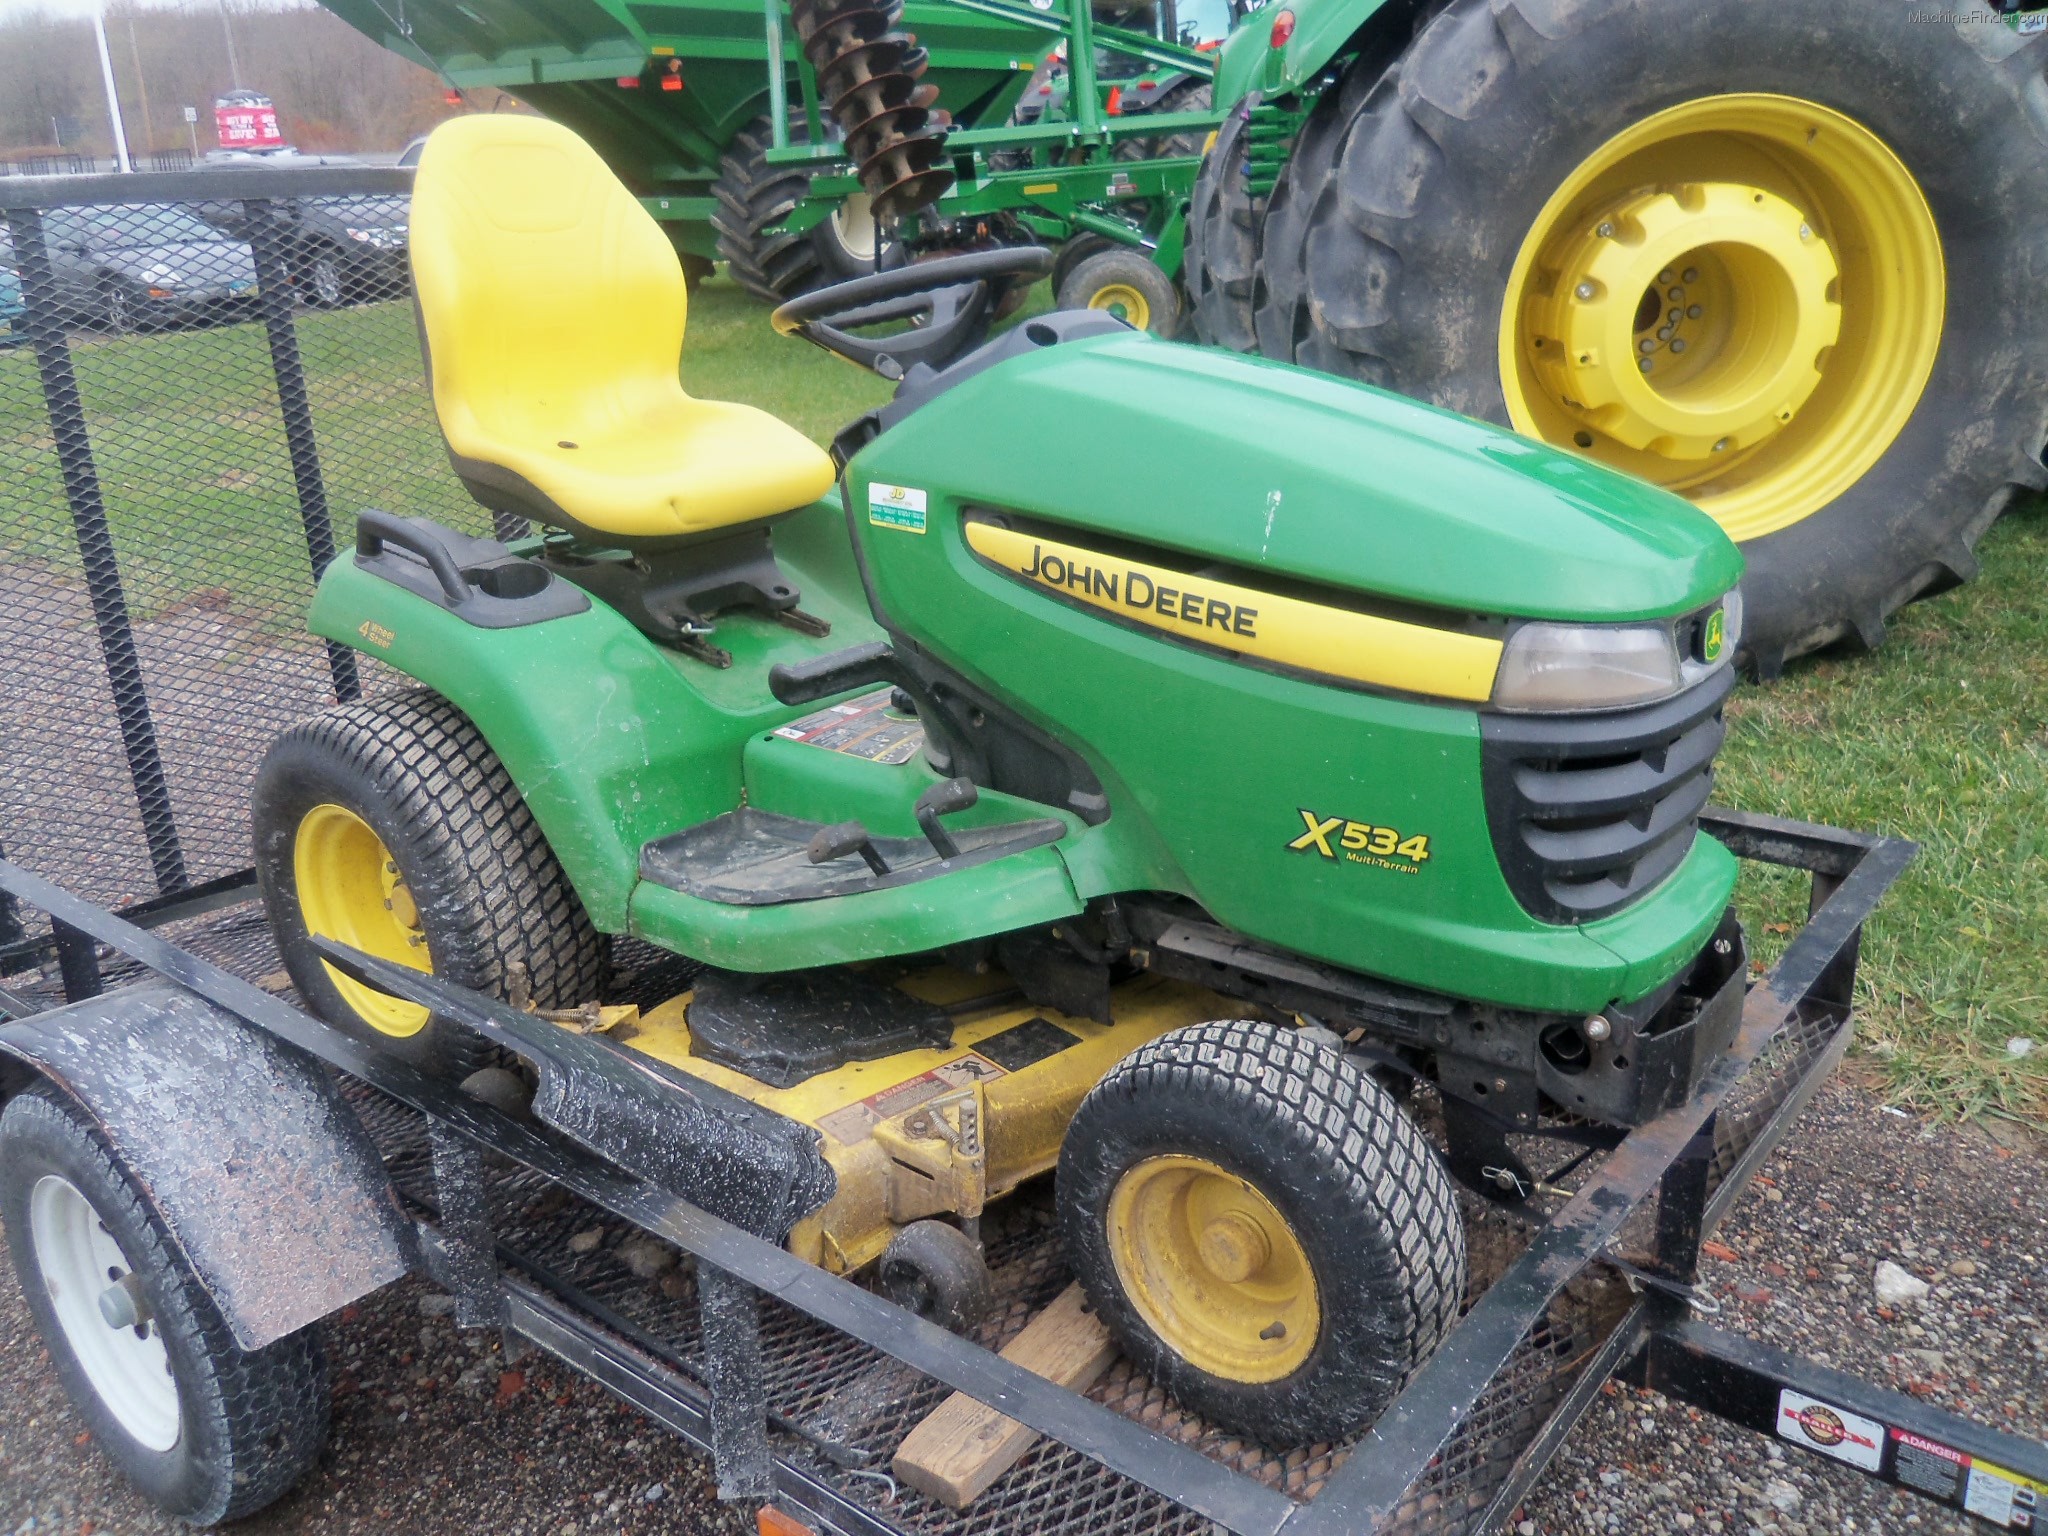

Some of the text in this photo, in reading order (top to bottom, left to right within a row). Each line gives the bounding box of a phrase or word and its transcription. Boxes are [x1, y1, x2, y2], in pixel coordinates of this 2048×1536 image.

[1021, 544, 1258, 639] JOHN DEERE
[358, 620, 370, 637] 4
[1286, 808, 1430, 863] X534
[1346, 852, 1419, 875] Multi-Terrain
[1909, 1435, 1962, 1463] DANGER
